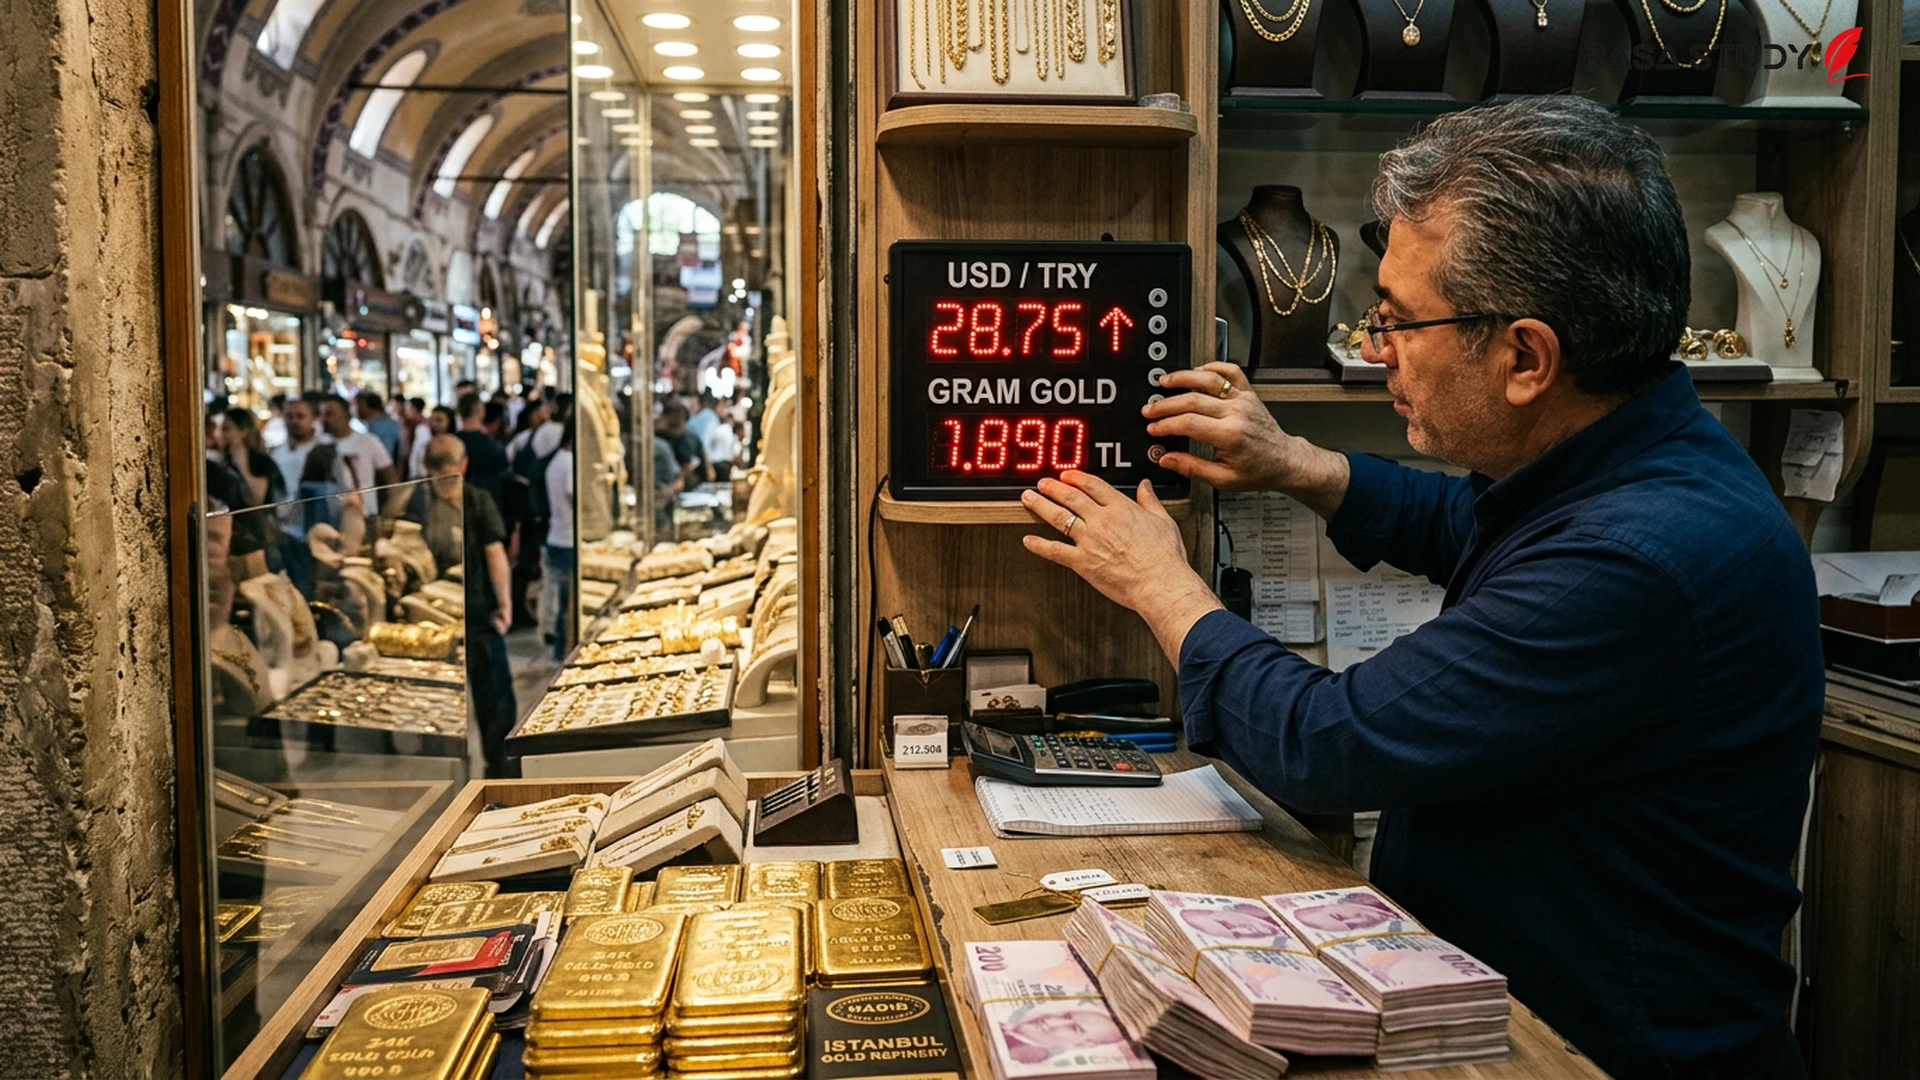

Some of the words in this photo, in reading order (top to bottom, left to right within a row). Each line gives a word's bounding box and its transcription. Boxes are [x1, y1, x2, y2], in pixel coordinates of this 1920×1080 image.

[948, 262, 1011, 288] USD
[1019, 262, 1030, 288] /
[1037, 262, 1098, 288] TRY
[931, 303, 1082, 356] 28.75
[928, 378, 1020, 404] GRAM
[1030, 378, 1117, 404] GOLD
[944, 419, 1084, 470] 1.890
[1095, 443, 1132, 467] TL
[975, 946, 1008, 973] 200
[824, 1036, 944, 1053] ISTANBUL
